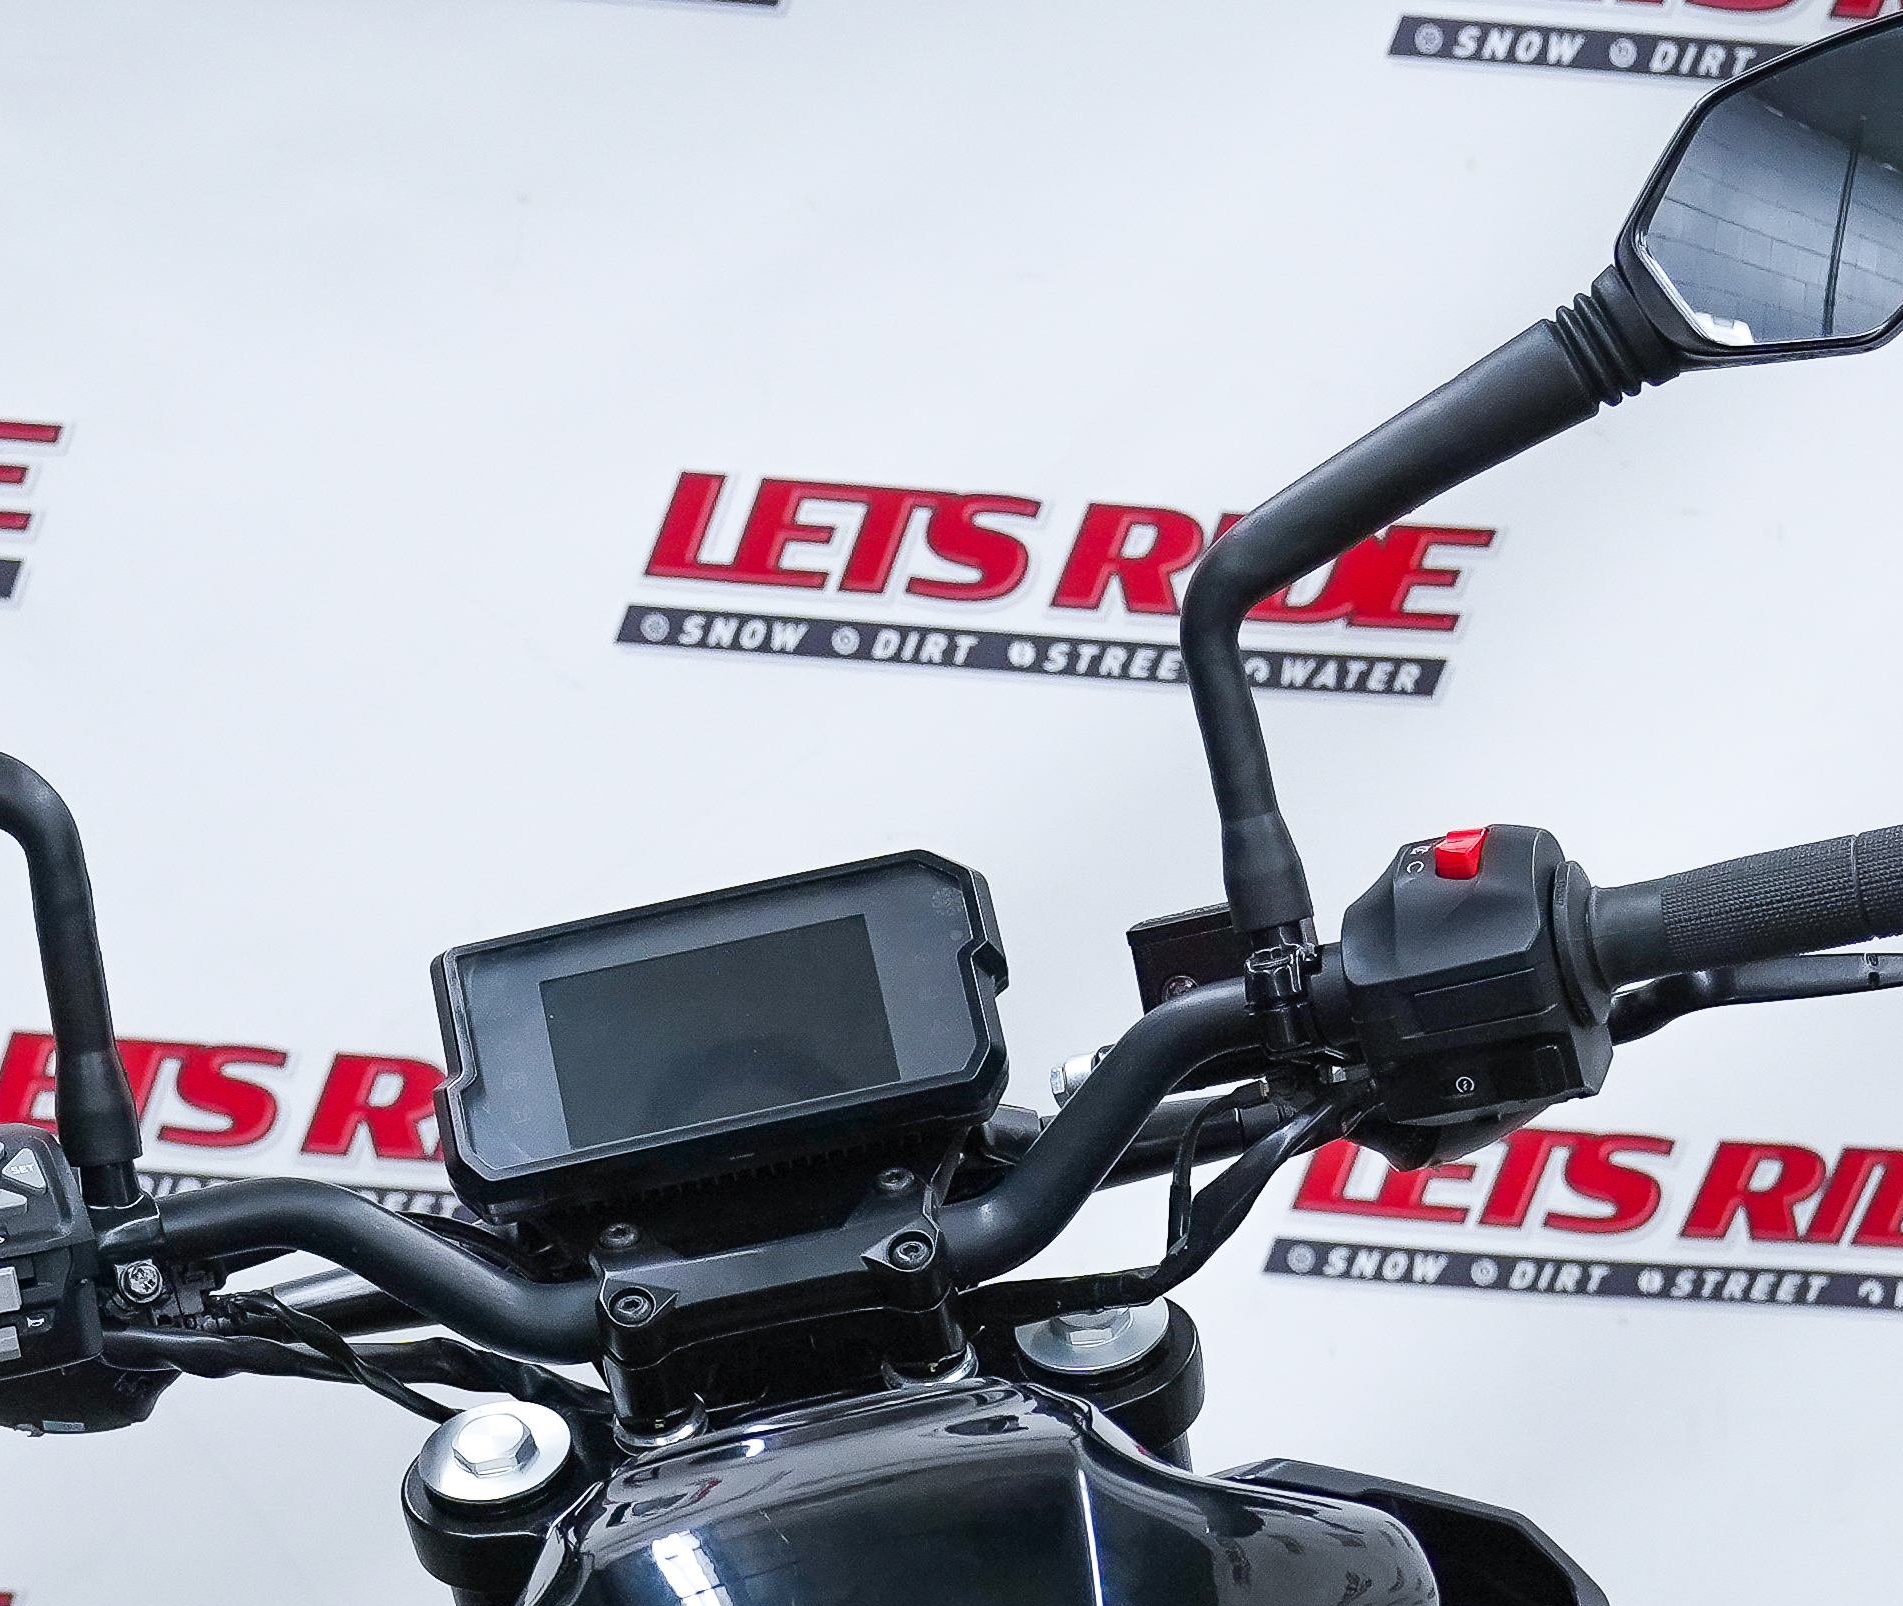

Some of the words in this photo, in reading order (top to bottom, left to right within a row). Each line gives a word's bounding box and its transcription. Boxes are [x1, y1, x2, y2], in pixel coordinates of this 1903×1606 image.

[1451, 23, 1587, 65] SNOW
[1647, 39, 1759, 78] DIRT
[646, 470, 1038, 603] LETS
[676, 613, 810, 652] SNOW
[869, 627, 980, 664] DIRT
[1041, 640, 1186, 680] STREE
[1279, 656, 1423, 694] WATER
[10, 1163, 35, 1176] SET
[1321, 1247, 1450, 1284] SNOW
[1507, 1259, 1611, 1292] DIRT
[1669, 1267, 1830, 1304] STREET
